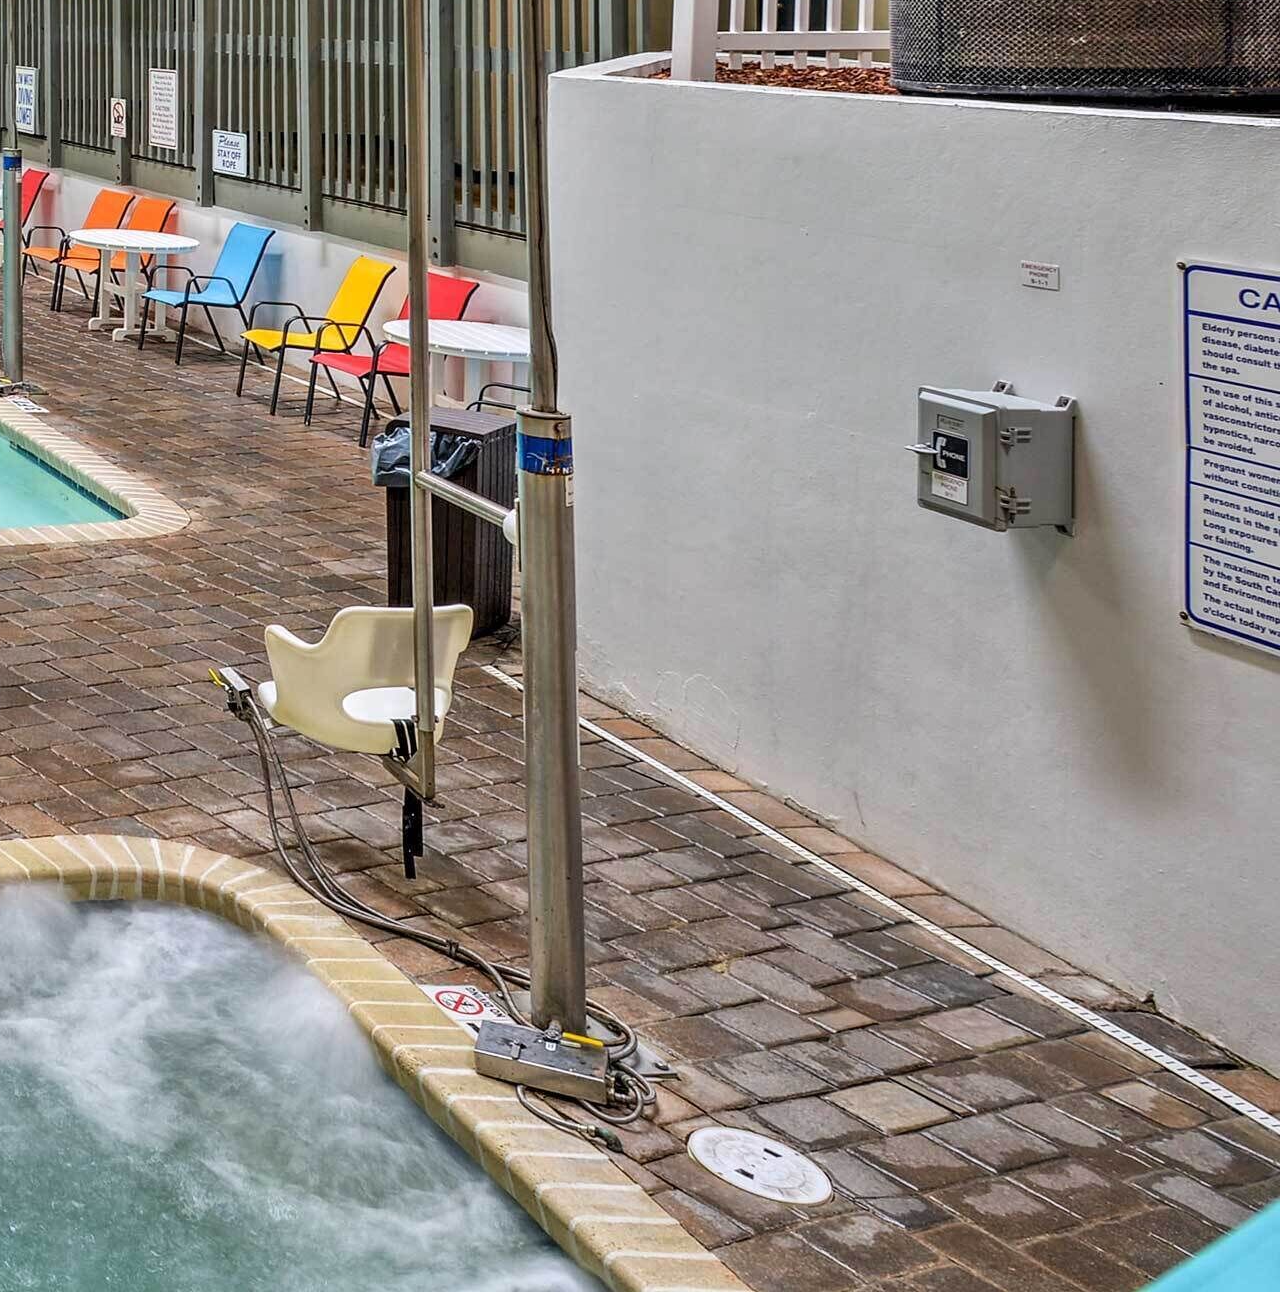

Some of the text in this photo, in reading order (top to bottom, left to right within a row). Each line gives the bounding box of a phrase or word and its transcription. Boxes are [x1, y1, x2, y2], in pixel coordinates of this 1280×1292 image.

[218, 135, 240, 147] Please
[217, 149, 241, 161] STAY OFF
[222, 159, 237, 170] ROPE
[1022, 262, 1057, 274] EMERGENCY
[1202, 323, 1276, 343] Elderly persons
[1202, 336, 1241, 351] disease,
[1202, 349, 1234, 361] should
[1236, 356, 1271, 369] consult
[1202, 361, 1240, 375] the spa.
[1202, 385, 1221, 395] The
[1223, 391, 1240, 400] use
[1242, 394, 1252, 402] of
[1255, 396, 1273, 407] this
[1203, 399, 1212, 407] of
[1215, 401, 1252, 416] alcohol,
[1203, 423, 1251, 442] hypnotics,
[1203, 436, 1256, 455] be avoided.
[942, 450, 966, 462] PHONE
[1203, 458, 1246, 476] Pregnant
[1203, 472, 1239, 487] without
[1203, 494, 1275, 520] Persons should
[1203, 508, 1241, 523] minutes
[1243, 517, 1252, 527] in
[1254, 521, 1271, 532] the
[1203, 519, 1226, 534] Long
[1229, 528, 1278, 548] exposures
[1203, 533, 1255, 554] or fainting.
[1203, 555, 1221, 567] The
[1224, 562, 1270, 582] maximum
[1203, 566, 1214, 577] by
[1217, 570, 1232, 582] the
[1234, 575, 1263, 592] South
[1203, 579, 1220, 590] and
[1203, 592, 1221, 605] The
[1224, 600, 1254, 616] actual
[1203, 606, 1236, 623] o'clock
[1239, 616, 1266, 634] today
[490, 1008, 506, 1018] NO
